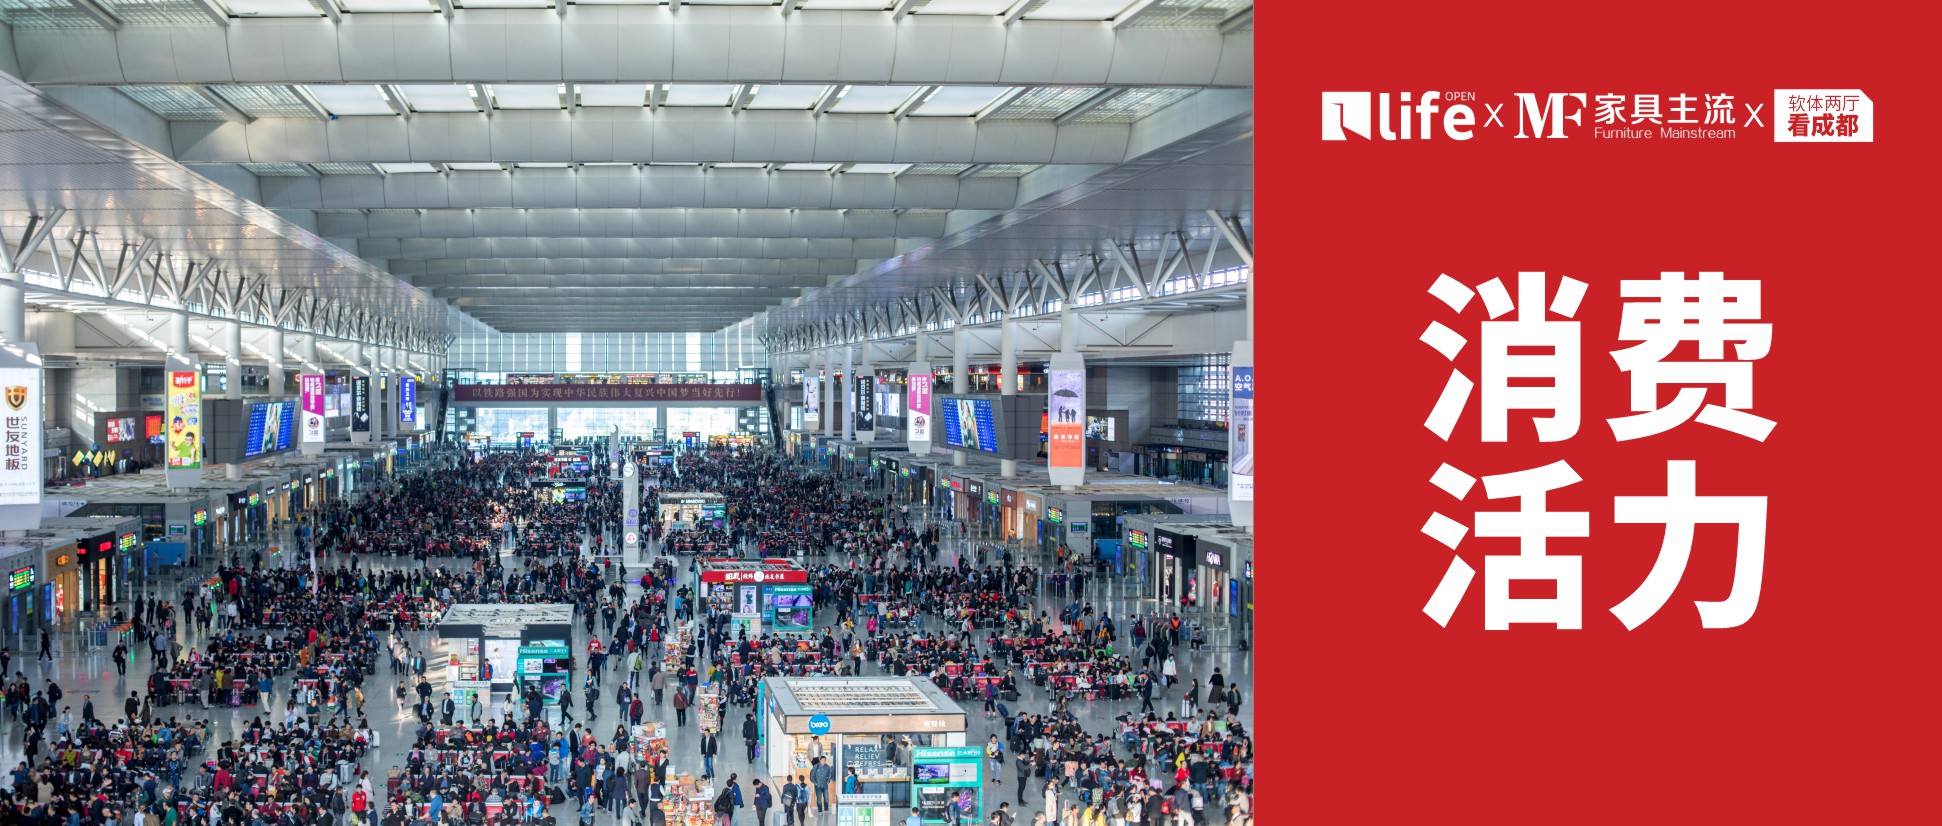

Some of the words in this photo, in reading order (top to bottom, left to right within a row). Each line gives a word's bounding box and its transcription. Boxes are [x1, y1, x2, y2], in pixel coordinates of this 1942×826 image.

[1234, 383, 1254, 391] 空气
[5, 416, 20, 470] 世友地板
